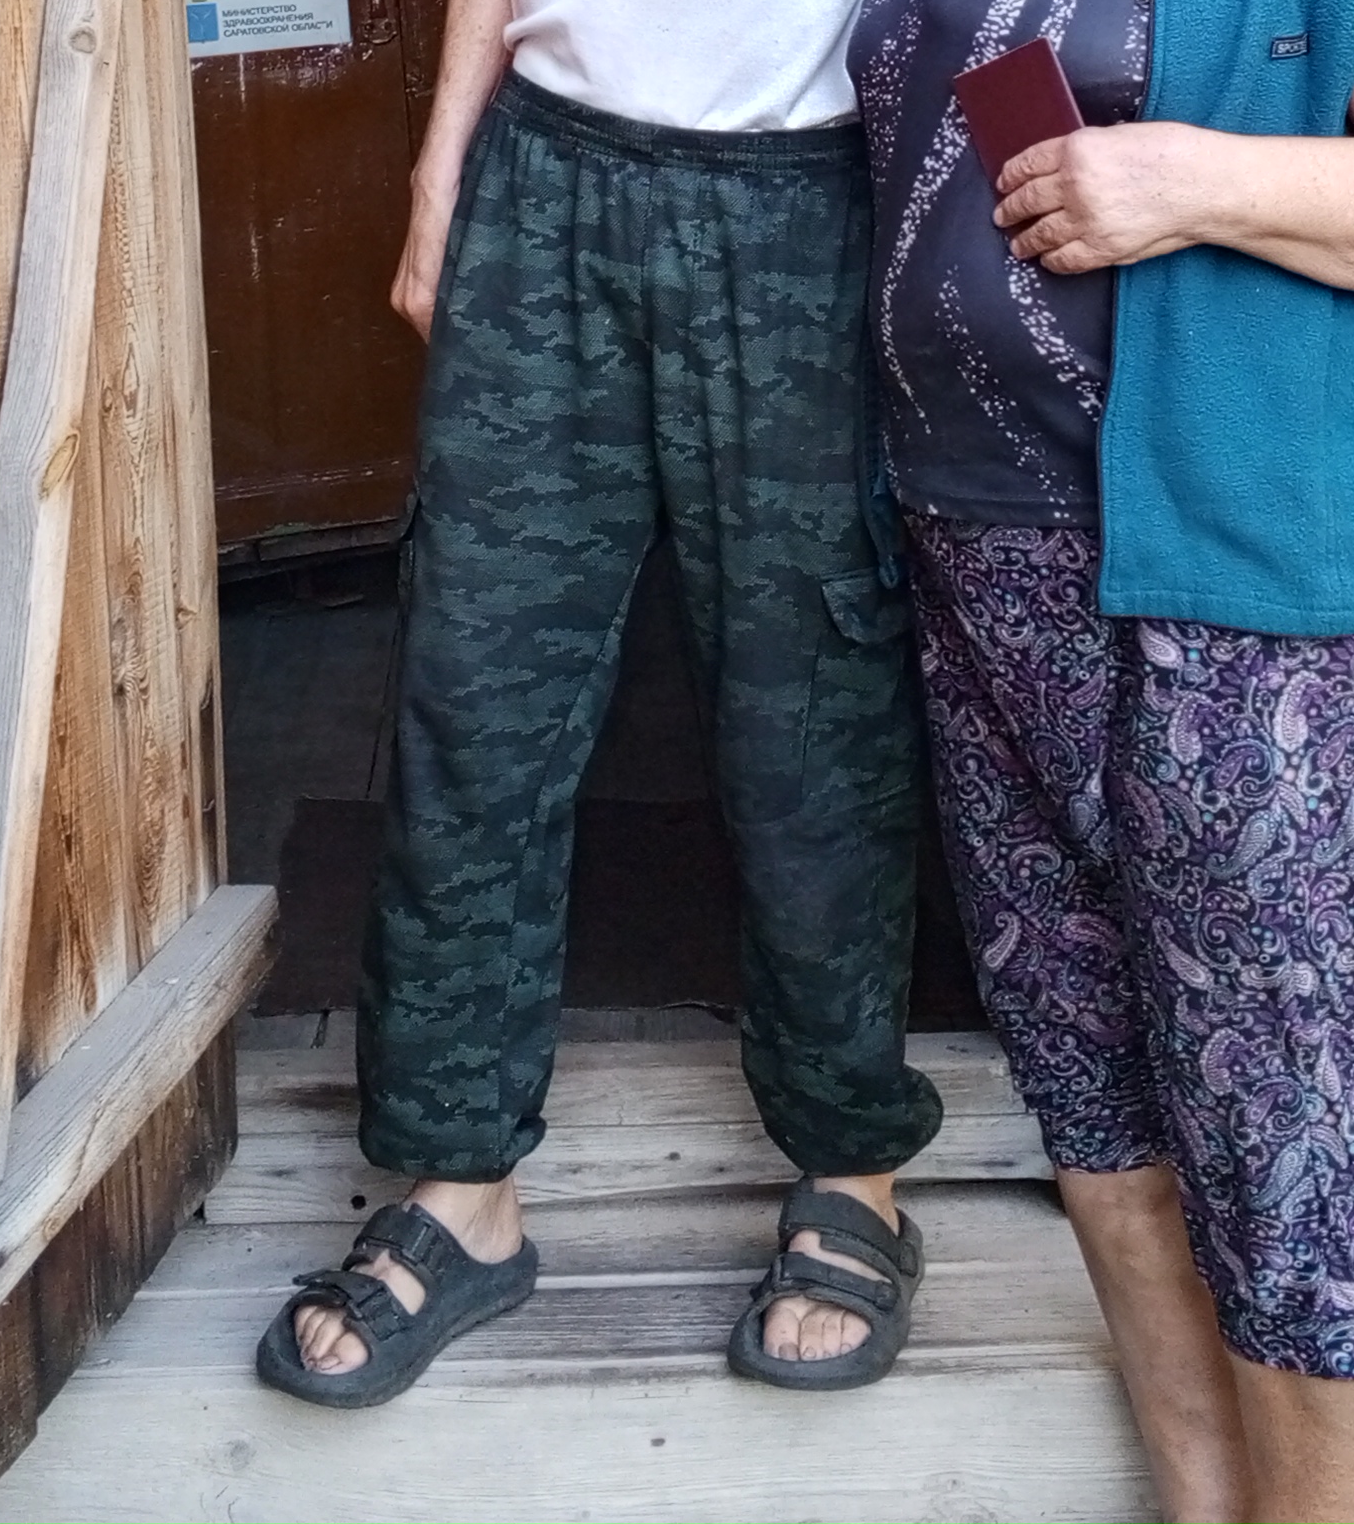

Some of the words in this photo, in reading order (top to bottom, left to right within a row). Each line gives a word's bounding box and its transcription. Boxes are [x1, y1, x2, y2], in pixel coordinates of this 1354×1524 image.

[222, 4, 297, 17] МИНИСТЕРСТВО
[223, 12, 314, 27] ЗДРАВООХРАНЕНИЯ
[223, 24, 290, 38] САРАТОВСКОЙ
[291, 20, 333, 32] ОБЛАСТИ
